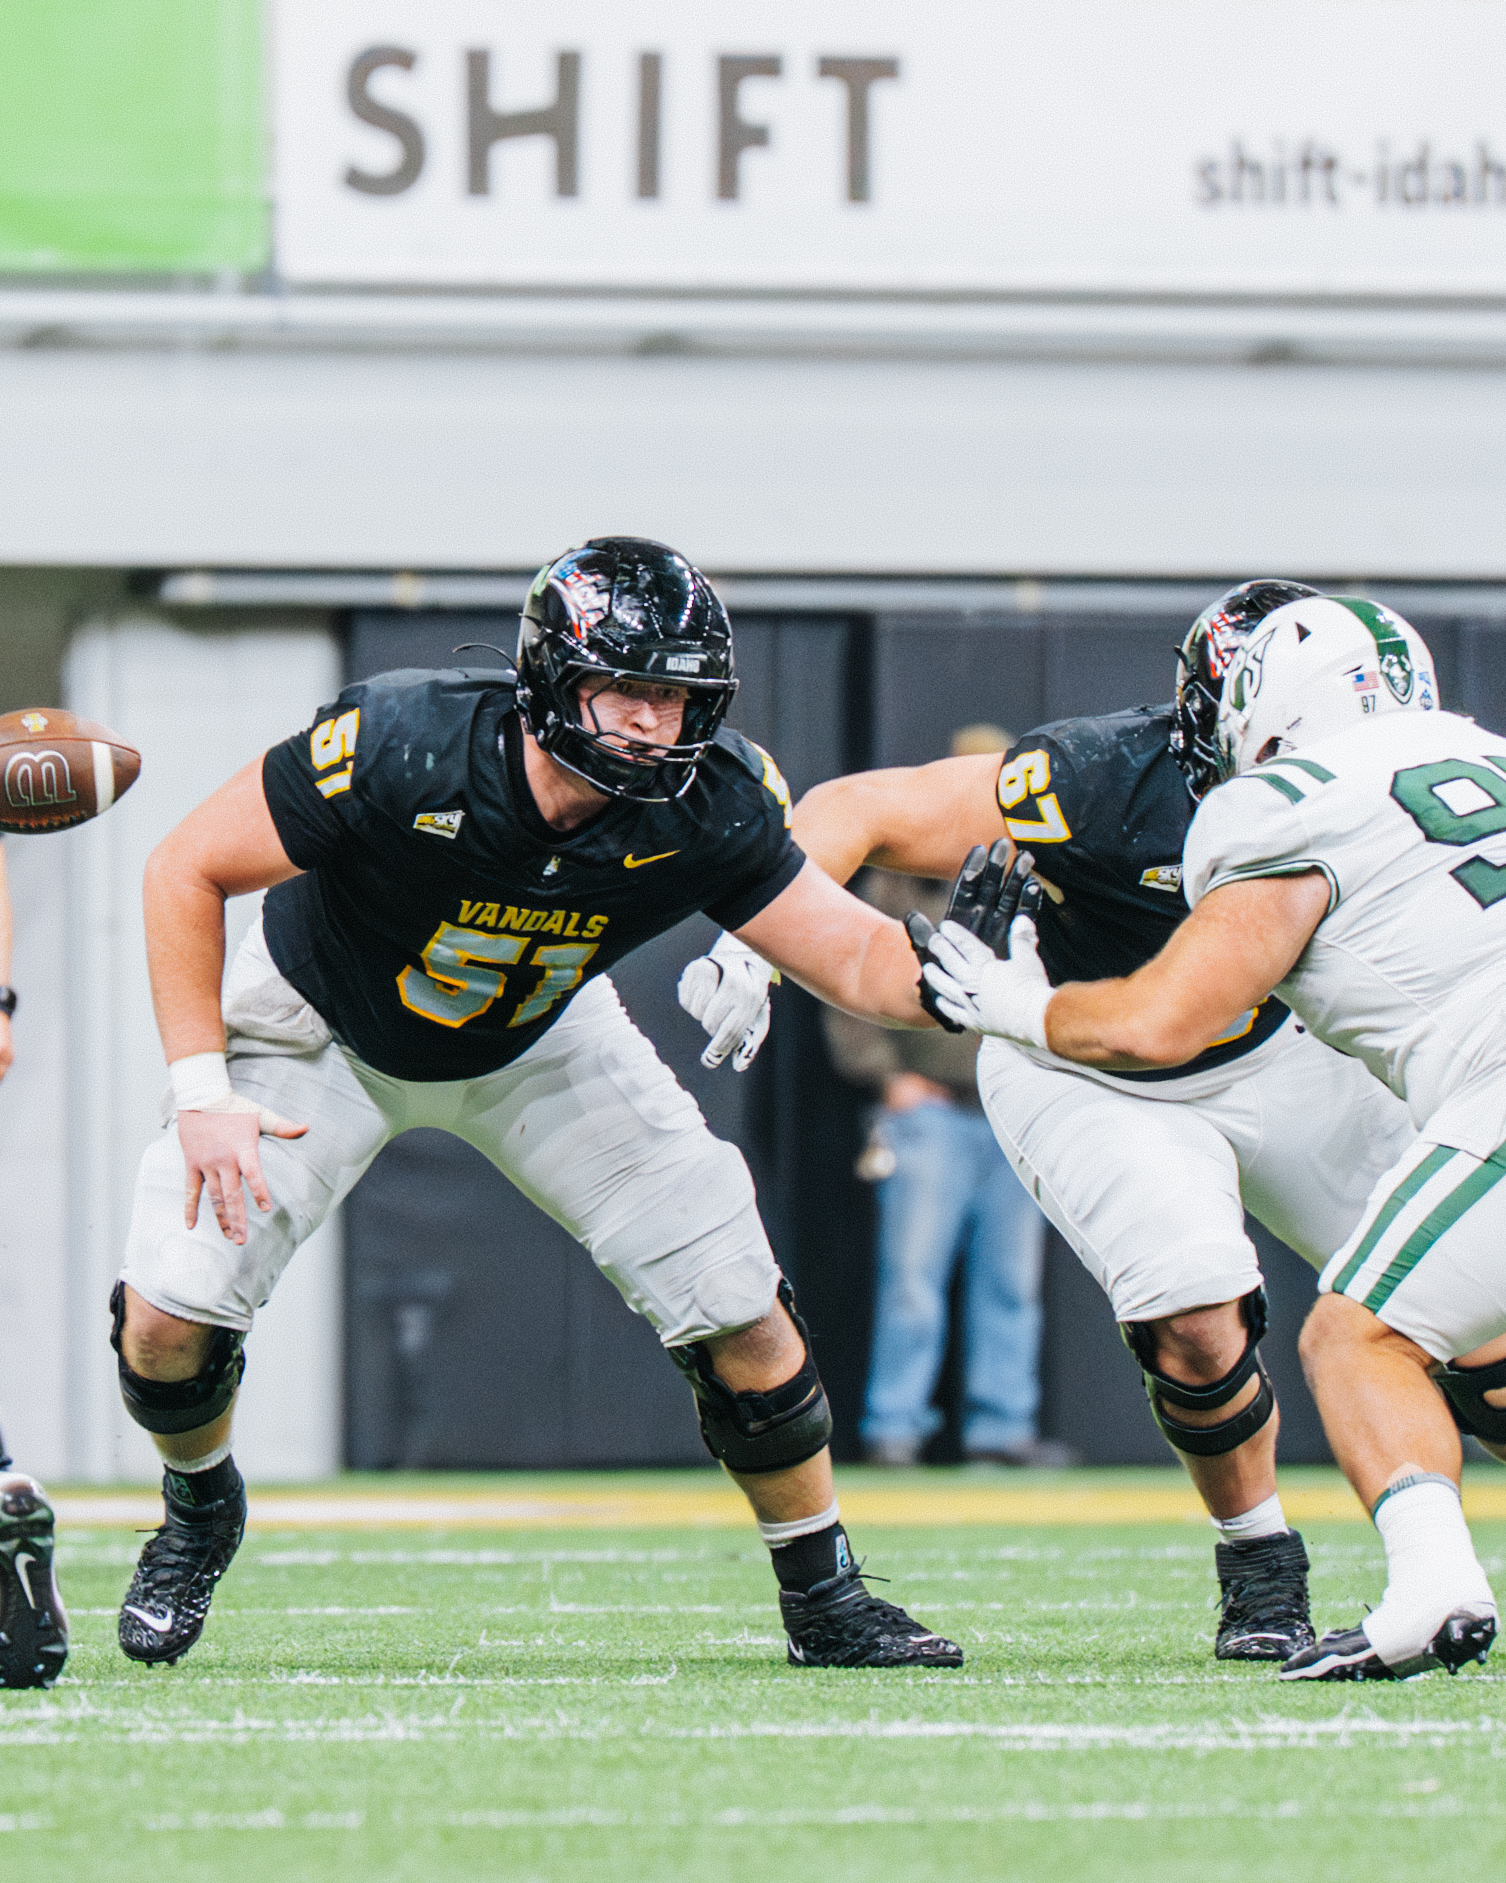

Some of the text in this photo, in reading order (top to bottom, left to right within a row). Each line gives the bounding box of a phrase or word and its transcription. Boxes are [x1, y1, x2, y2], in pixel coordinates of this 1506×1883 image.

[343, 45, 900, 203] SHIFT
[1361, 694, 1376, 713] 97
[998, 749, 1072, 844] 67
[458, 899, 609, 938] VANDALS
